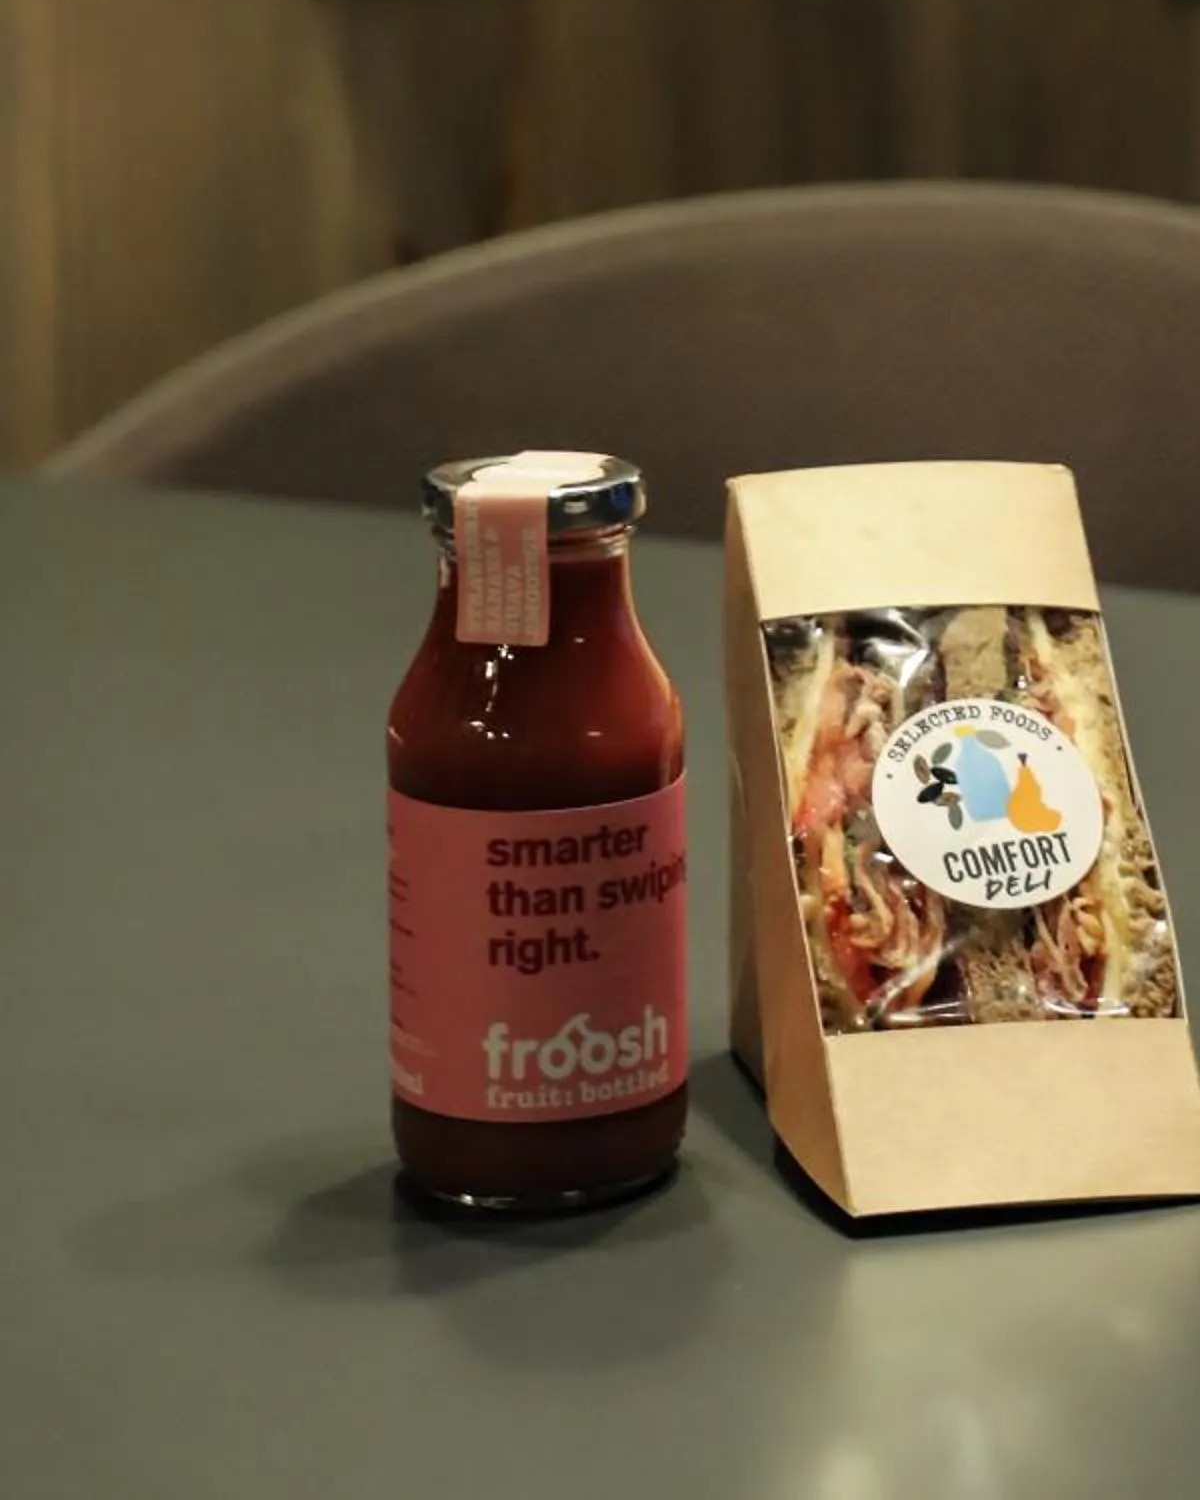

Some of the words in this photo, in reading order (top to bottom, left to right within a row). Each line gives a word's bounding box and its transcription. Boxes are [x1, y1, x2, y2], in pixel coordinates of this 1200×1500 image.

[887, 705, 981, 762] SELECTED
[989, 705, 1053, 742] FOODS
[486, 825, 649, 867] smarter
[943, 832, 1071, 883] COMFORT
[486, 880, 584, 916] than
[985, 869, 1054, 900] DELI
[488, 927, 600, 975] right.
[481, 1003, 668, 1080] froosh
[487, 1084, 574, 1108] fruit:
[579, 1059, 669, 1104] bottled
